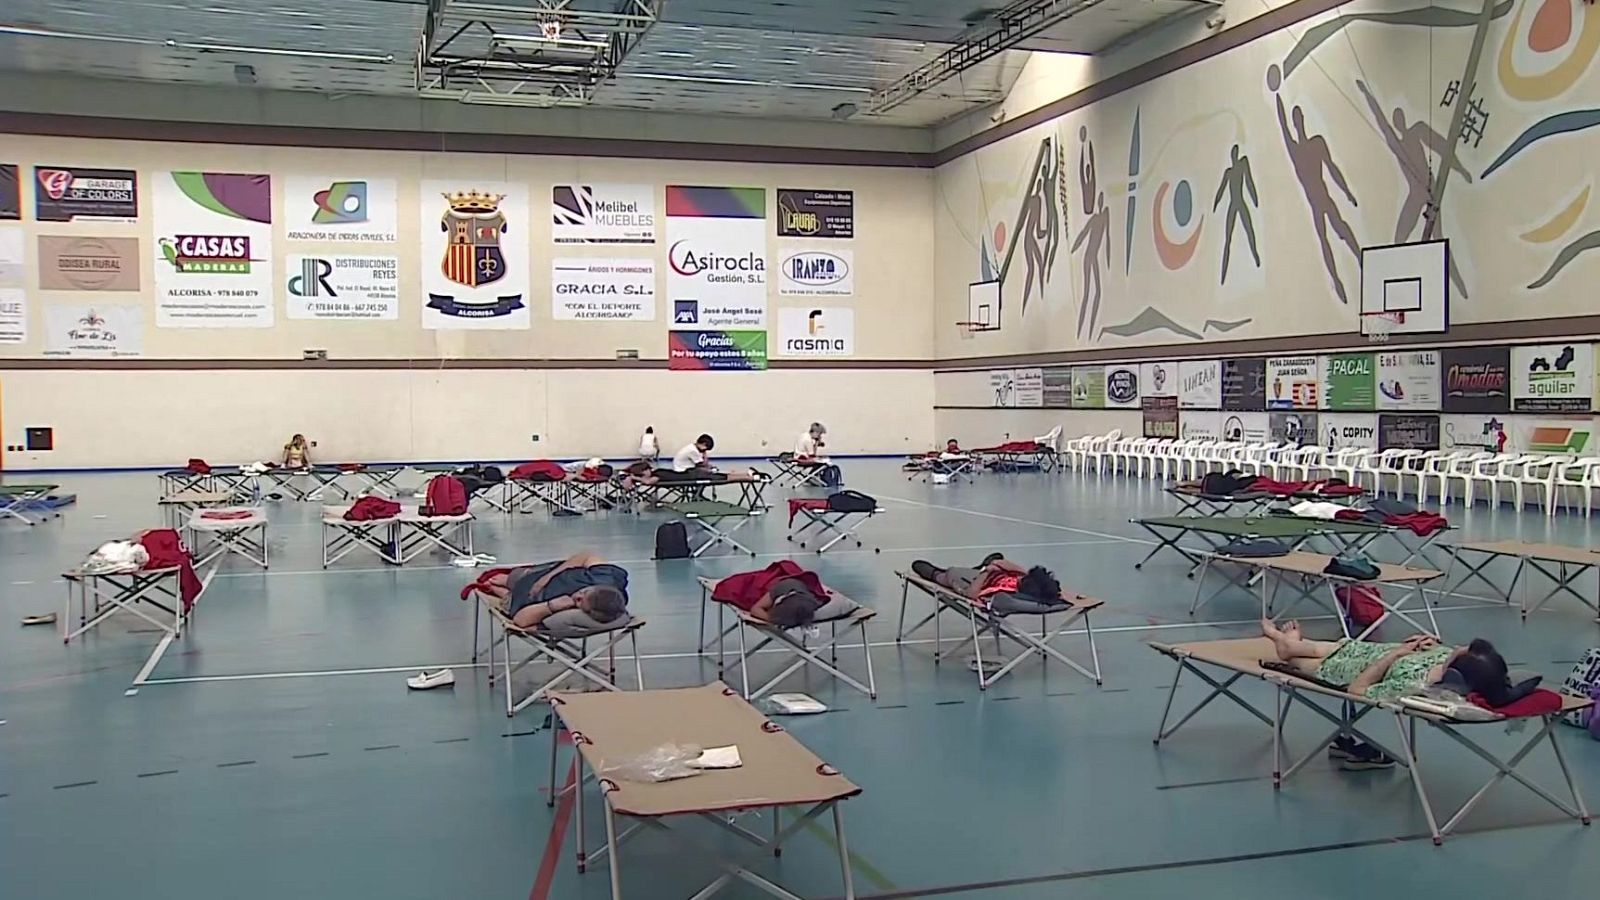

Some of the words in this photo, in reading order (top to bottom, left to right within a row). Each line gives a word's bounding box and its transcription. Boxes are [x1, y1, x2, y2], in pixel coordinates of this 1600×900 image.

[87, 180, 129, 189] GARAGE
[72, 189, 86, 199] OF
[88, 190, 128, 200] COLORS
[595, 201, 638, 213] Melibel
[595, 214, 653, 227] MUEBLES
[787, 213, 817, 231] LAURA
[287, 232, 326, 240] ARAGONESA
[328, 232, 337, 240] DE
[339, 233, 358, 241] OBRAS
[181, 236, 245, 257] CASAS
[92, 260, 120, 269] RURAL
[335, 259, 397, 269] DISTRIBUCIONES
[681, 250, 766, 271] Asirocla
[182, 263, 245, 271] MADERAS
[792, 258, 835, 280] IRANZO
[372, 270, 397, 279] REYES
[707, 274, 746, 284] Gestión,
[747, 275, 765, 283] S.L.
[168, 289, 213, 297] ALCORISA
[556, 284, 618, 294] GRACIA
[623, 285, 654, 295] S.L.
[68, 330, 86, 340] Flor
[698, 333, 735, 347] Gracias
[694, 350, 719, 359] apoyo
[720, 350, 740, 358] estos
[1333, 360, 1371, 375] PACAL
[1529, 380, 1575, 396] aguilar
[1343, 427, 1374, 438] COPITY
